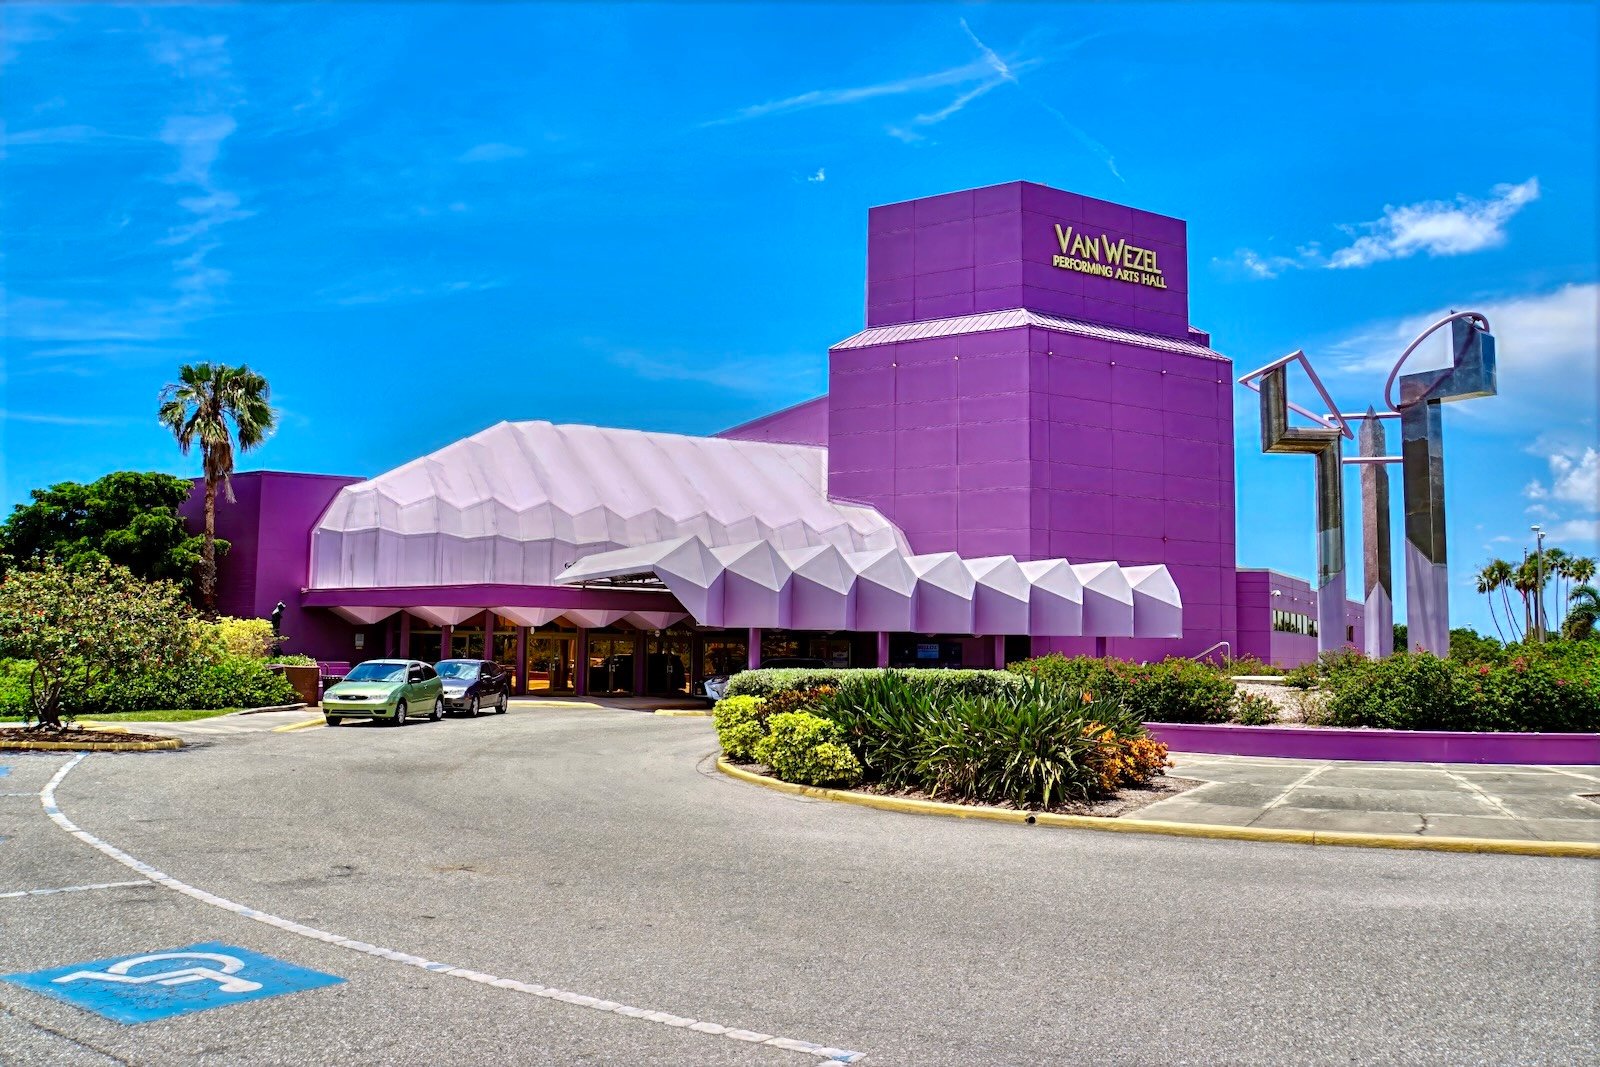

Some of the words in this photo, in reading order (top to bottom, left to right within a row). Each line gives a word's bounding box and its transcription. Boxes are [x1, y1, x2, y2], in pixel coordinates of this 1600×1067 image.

[1054, 223, 1100, 261] VAN
[1101, 234, 1162, 275] WEZEL
[1052, 254, 1113, 278] PERFORMING
[1115, 268, 1140, 283] ARTS
[1141, 273, 1168, 289] HALL
